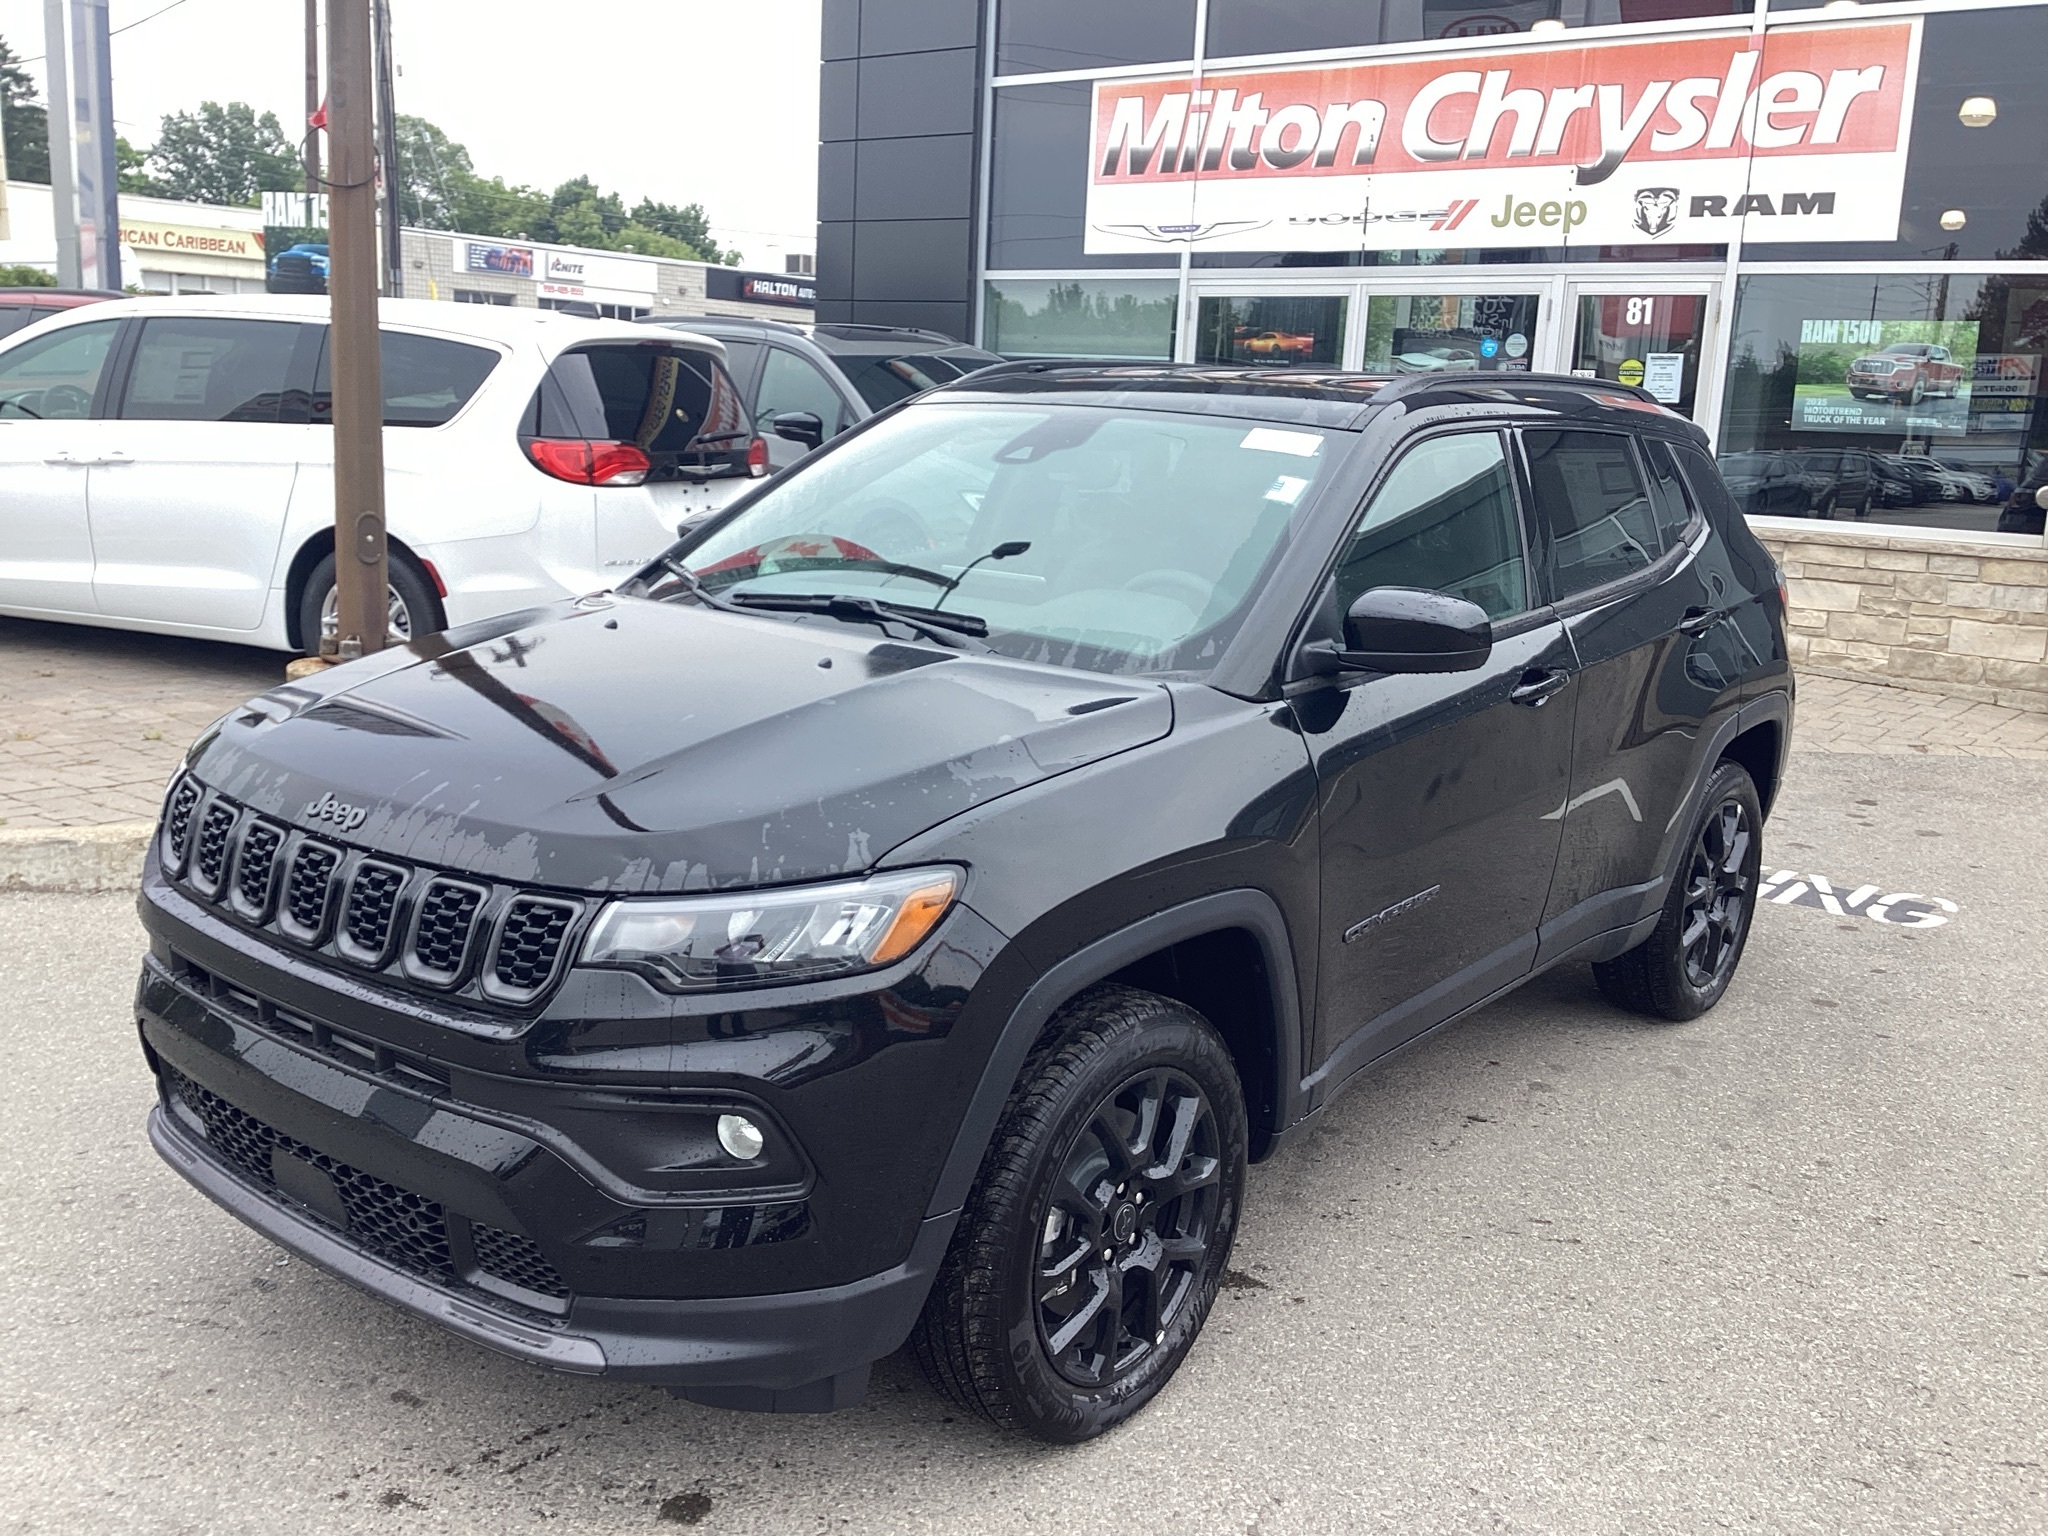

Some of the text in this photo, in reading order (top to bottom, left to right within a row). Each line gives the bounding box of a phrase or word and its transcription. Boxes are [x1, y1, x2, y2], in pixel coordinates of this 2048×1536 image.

[1100, 50, 1885, 186] Milton Chrysler
[261, 191, 306, 228] RAM
[1491, 194, 1587, 234] Jeep
[1689, 192, 1836, 218] RAM
[163, 231, 246, 254] CARIBBEAN
[753, 280, 797, 297] HALTON
[1625, 297, 1653, 325] 81
[1801, 320, 1881, 344] RAM 1500
[1804, 406, 1862, 416] MOTORTREND
[1805, 398, 1827, 406] 2025
[1803, 415, 1832, 424] TRUCK
[1833, 415, 1846, 424] OF
[1848, 416, 1861, 425] THE
[306, 791, 368, 833] Jeep
[1757, 865, 1960, 929] ING
